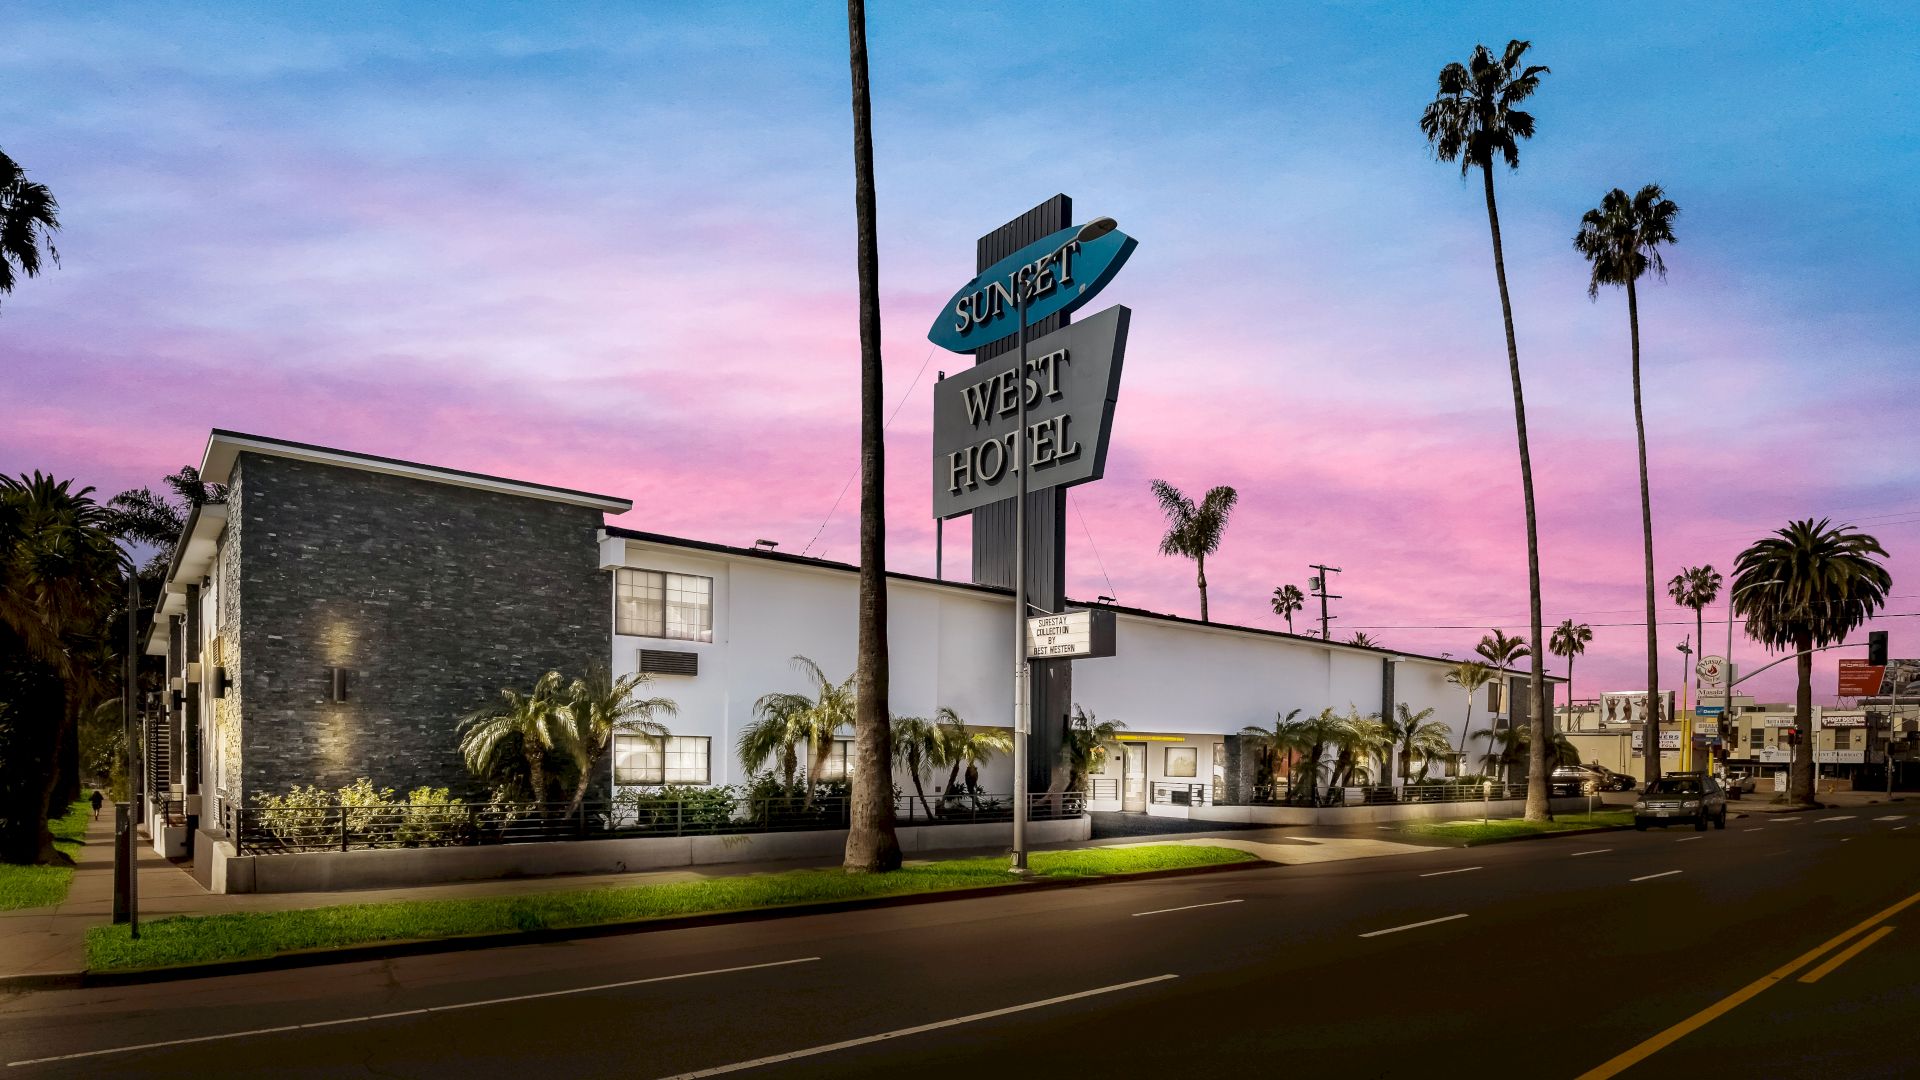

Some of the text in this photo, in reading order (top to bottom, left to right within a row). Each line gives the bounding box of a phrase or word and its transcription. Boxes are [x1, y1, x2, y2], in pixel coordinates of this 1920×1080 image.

[956, 241, 1077, 332] SUNSET
[960, 348, 1066, 425] WEST
[948, 413, 1078, 491] HOTEL
[1038, 616, 1067, 627] SURESTAY
[1036, 626, 1069, 636] COLLECTION
[1048, 636, 1056, 645] BY
[1033, 644, 1075, 655] BEST WESTERN
